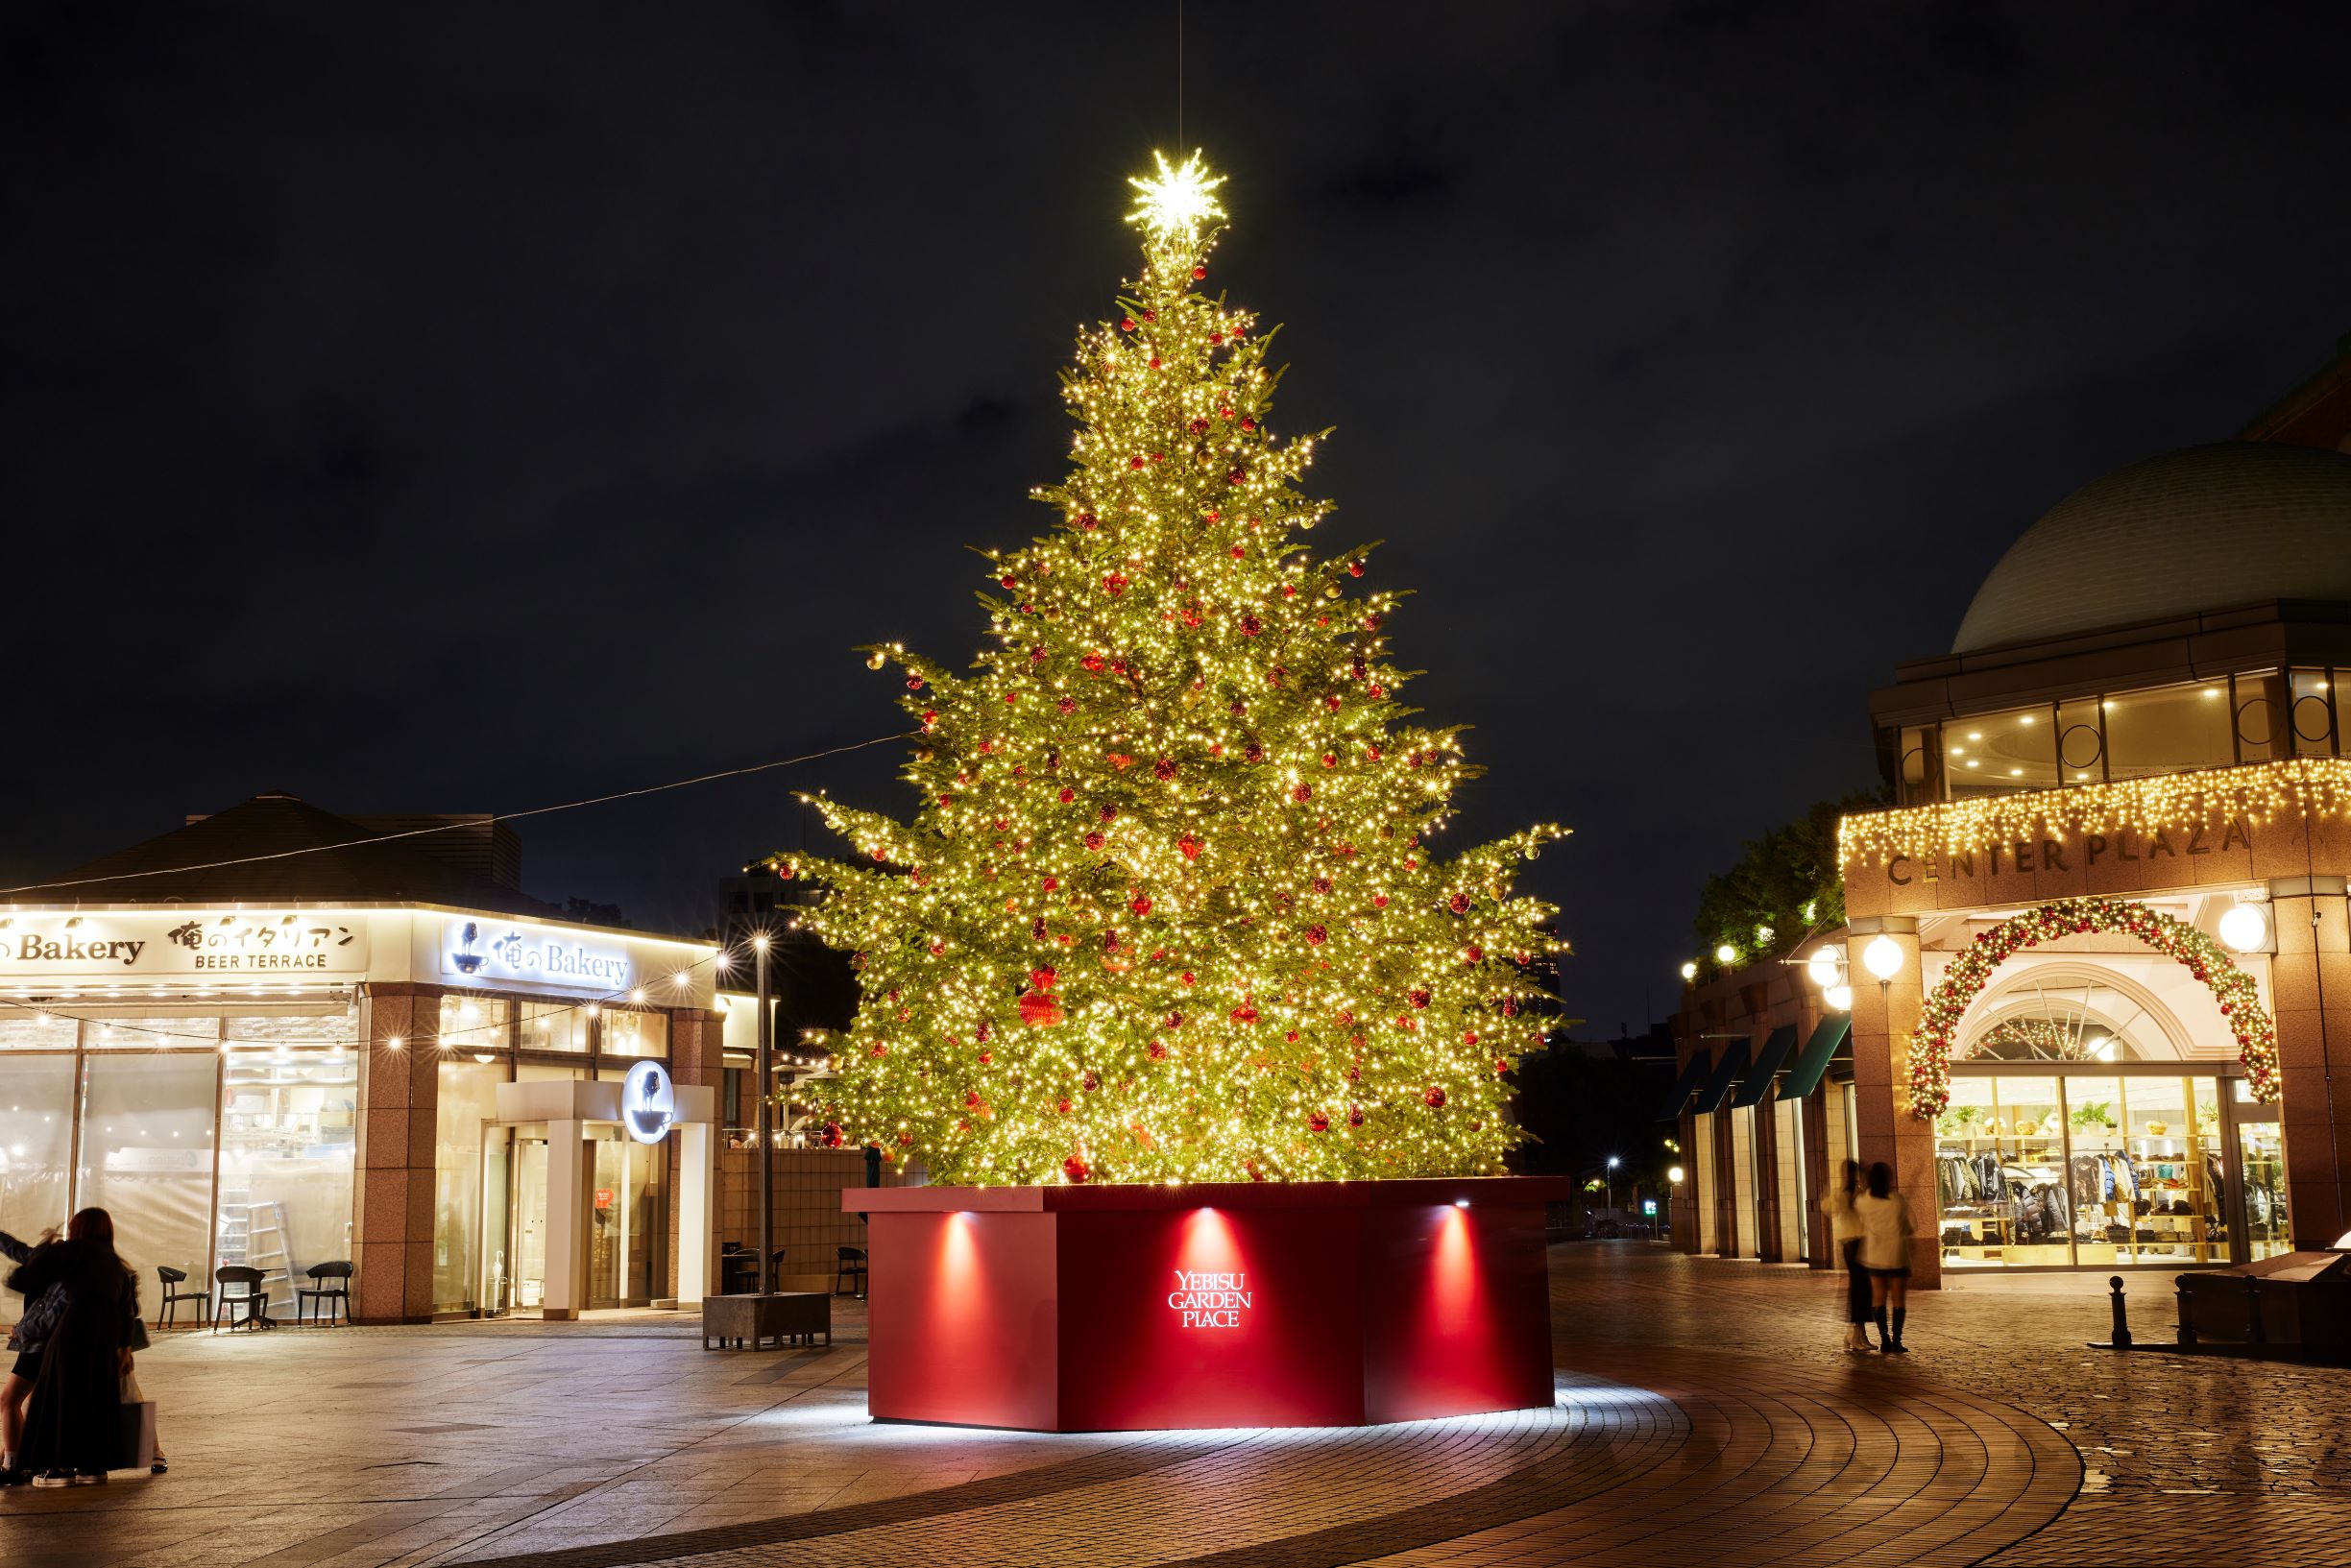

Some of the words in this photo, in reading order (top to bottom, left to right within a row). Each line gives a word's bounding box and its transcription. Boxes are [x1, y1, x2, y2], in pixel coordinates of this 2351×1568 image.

[1888, 840, 2069, 886] CENTER
[2087, 817, 2251, 866] PLAZA
[167, 920, 354, 950] 俺のイタリアン
[196, 955, 239, 968] BEER
[248, 954, 327, 968] TERRACE
[1174, 1269, 1246, 1291] YEBISU
[1168, 1291, 1252, 1310] GARDEN
[1182, 1310, 1240, 1328] PLACE
